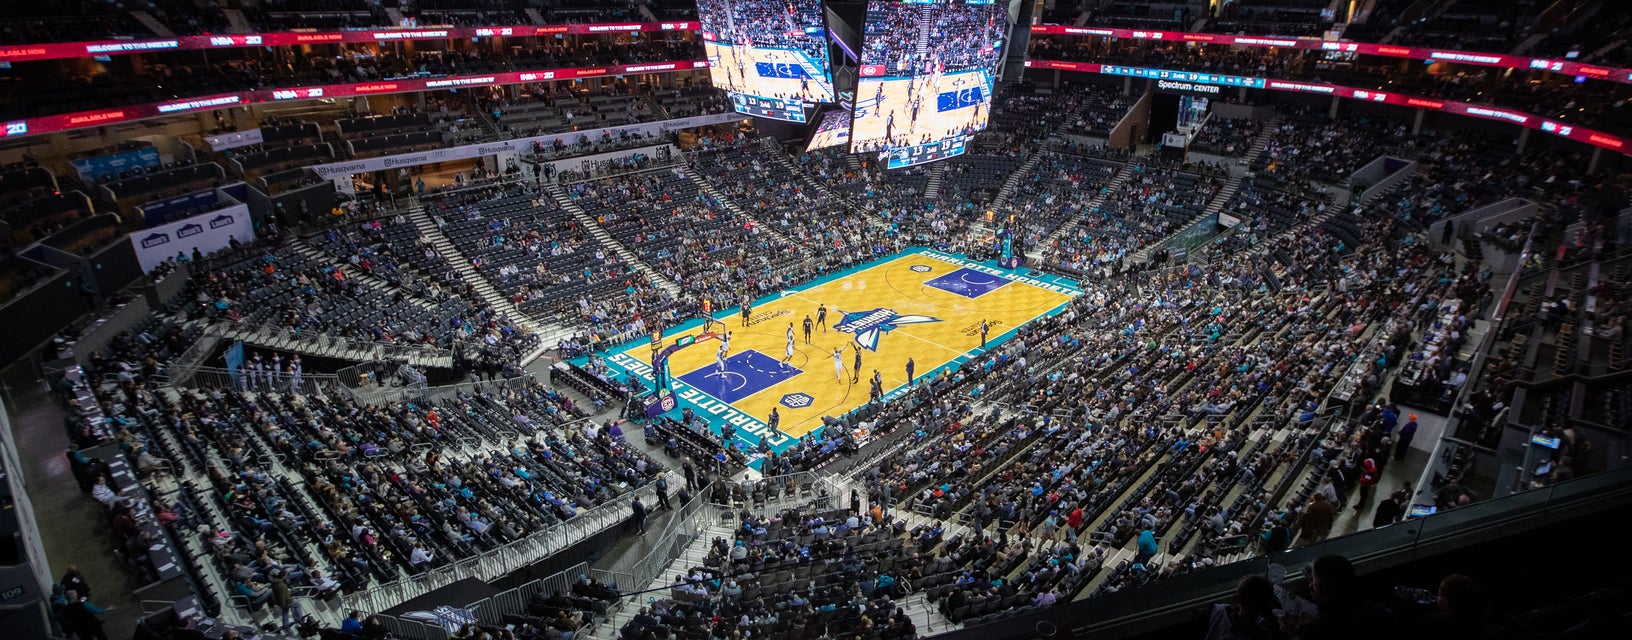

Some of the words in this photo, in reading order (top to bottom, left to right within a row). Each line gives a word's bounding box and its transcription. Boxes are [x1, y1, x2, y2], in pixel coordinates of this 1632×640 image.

[1158, 79, 1191, 91] Spectrum
[1193, 84, 1219, 93] CENTER
[749, 97, 756, 105] 13
[775, 101, 784, 109] 19
[912, 146, 922, 156] 13
[941, 140, 951, 151] 19
[391, 156, 427, 166] Husqvarna
[326, 164, 366, 174] Husqvarna
[919, 250, 1003, 277] CHARLOTTE
[1003, 273, 1084, 298] HORNETS
[840, 308, 897, 333] HORNETS
[677, 388, 789, 447] CHARLOTTE
[1, 587, 22, 600] 109
